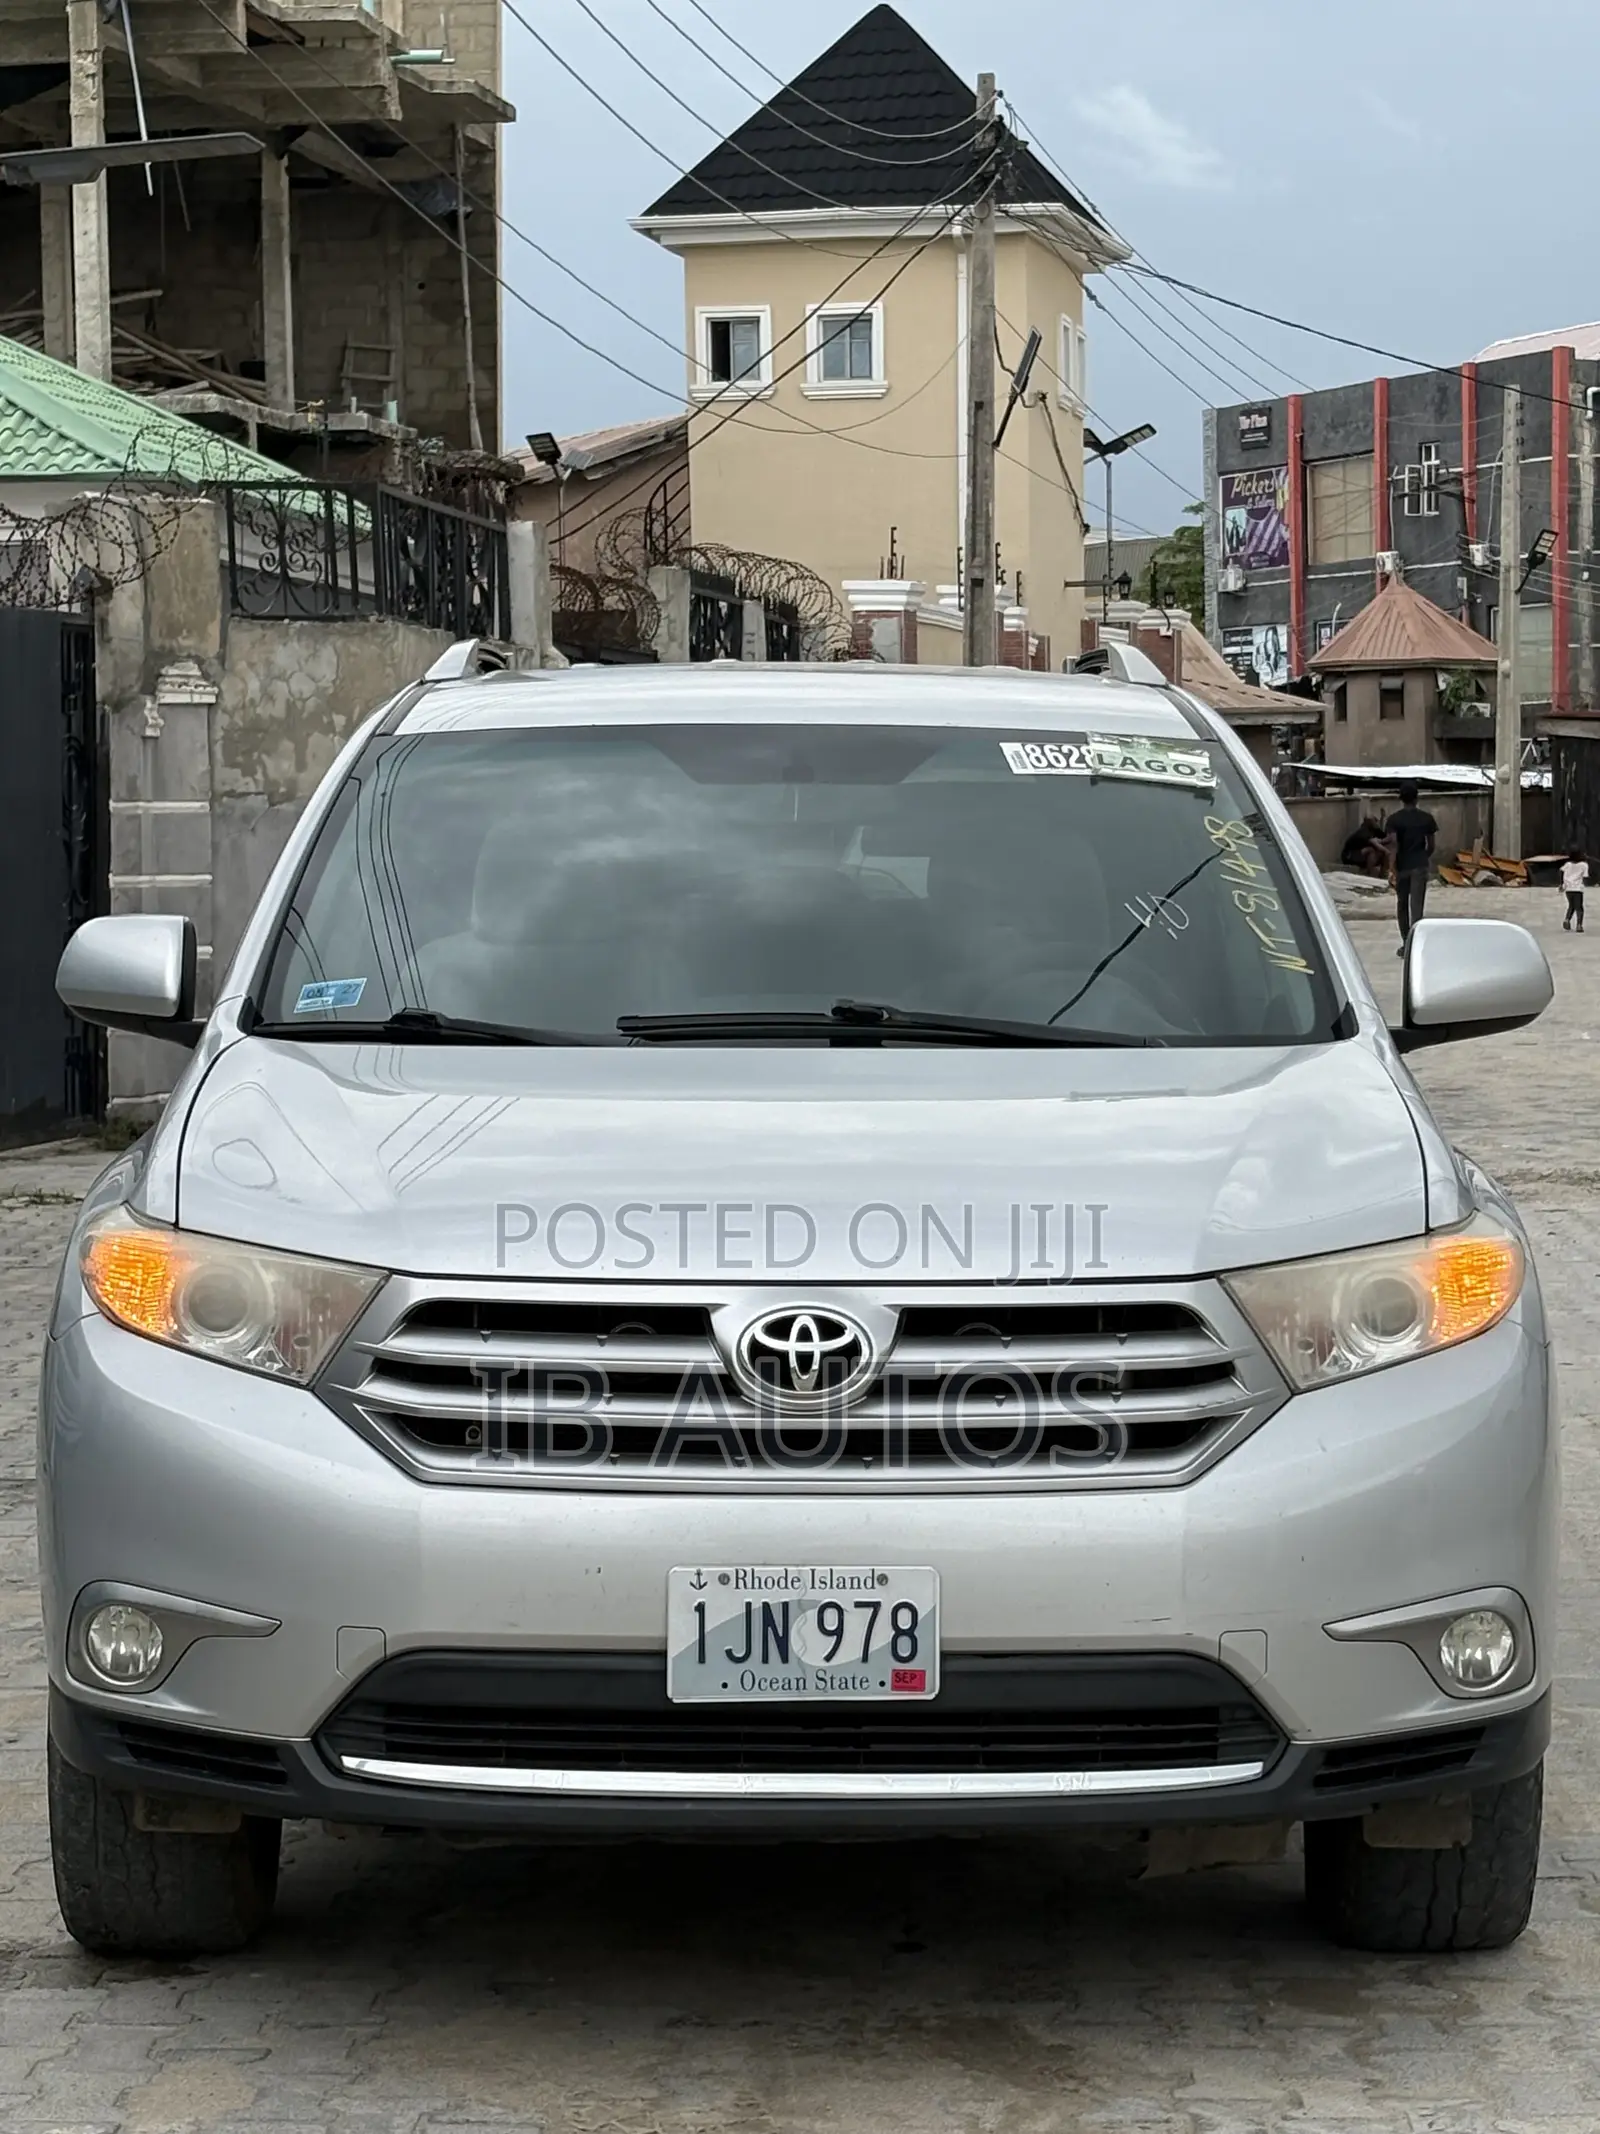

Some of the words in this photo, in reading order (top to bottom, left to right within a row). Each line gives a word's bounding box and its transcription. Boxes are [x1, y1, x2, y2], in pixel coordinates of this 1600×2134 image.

[1097, 752, 1216, 781] LAGOS
[734, 1569, 801, 1590] Rhode
[809, 1569, 877, 1590] Island
[816, 1601, 919, 1664] 978
[740, 1669, 807, 1691] Ocean
[815, 1669, 870, 1692] State
[894, 1671, 917, 1684] SEP
